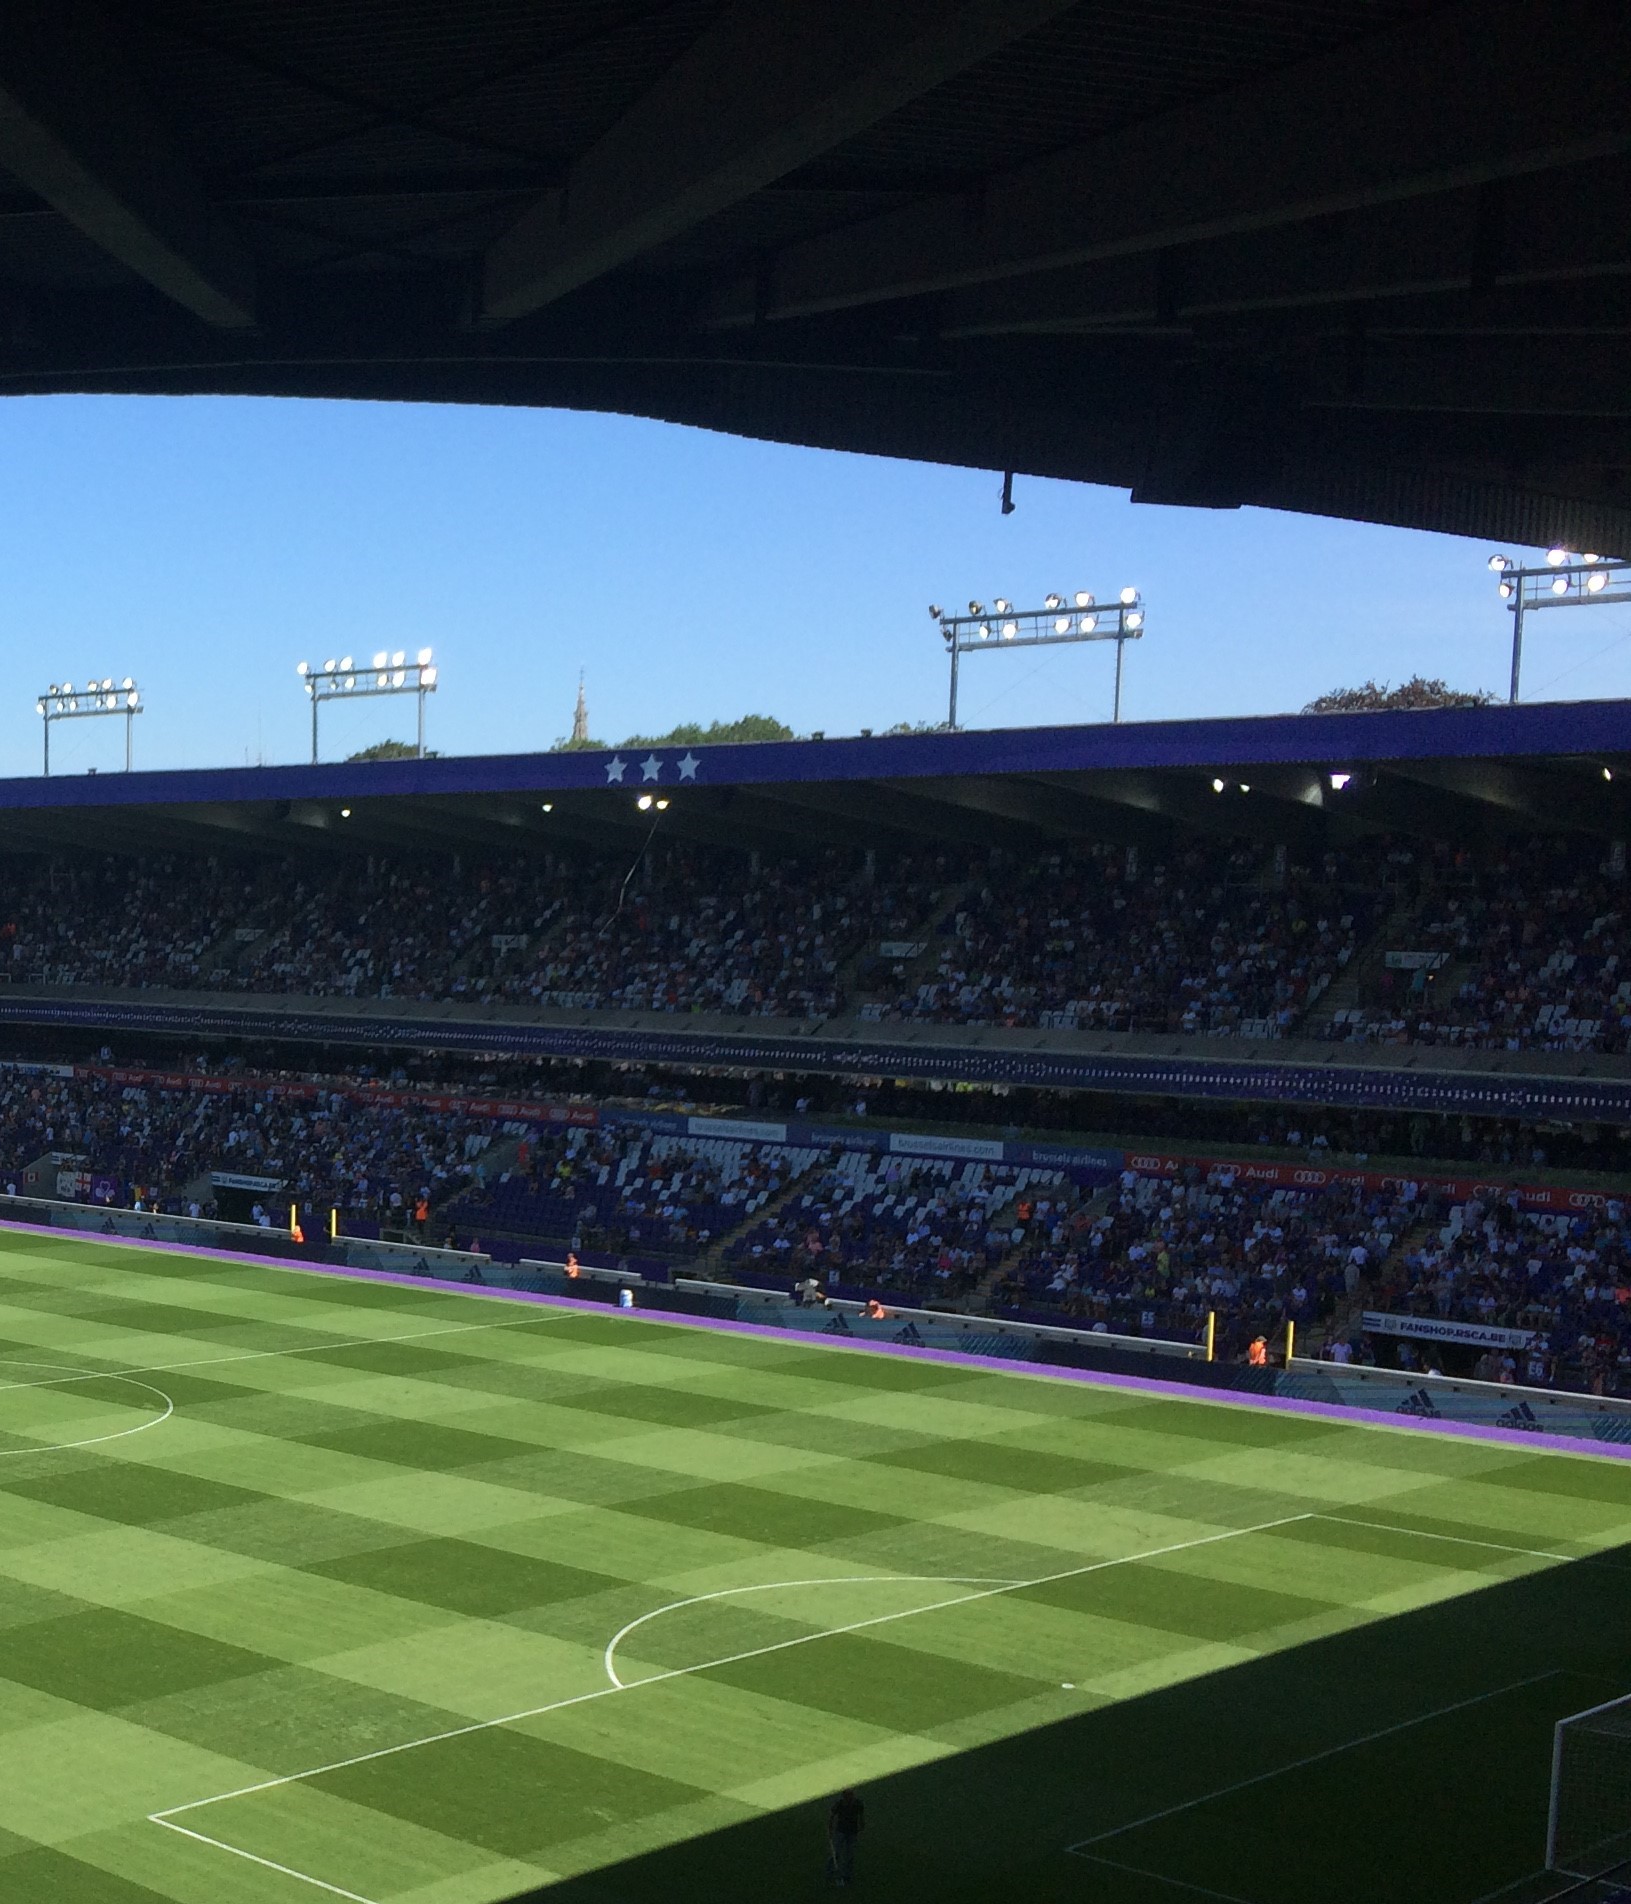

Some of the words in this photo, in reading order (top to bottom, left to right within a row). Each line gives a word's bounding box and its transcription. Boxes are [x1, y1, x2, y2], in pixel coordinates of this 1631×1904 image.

[1032, 1150, 1069, 1164] brussels
[1072, 1154, 1108, 1167] airlines
[1246, 1167, 1278, 1179] Audi
[1524, 1191, 1551, 1203] udi
[1400, 1322, 1506, 1342] FANSHOP.RSCA.BE
[1496, 1418, 1544, 1432] adidas
